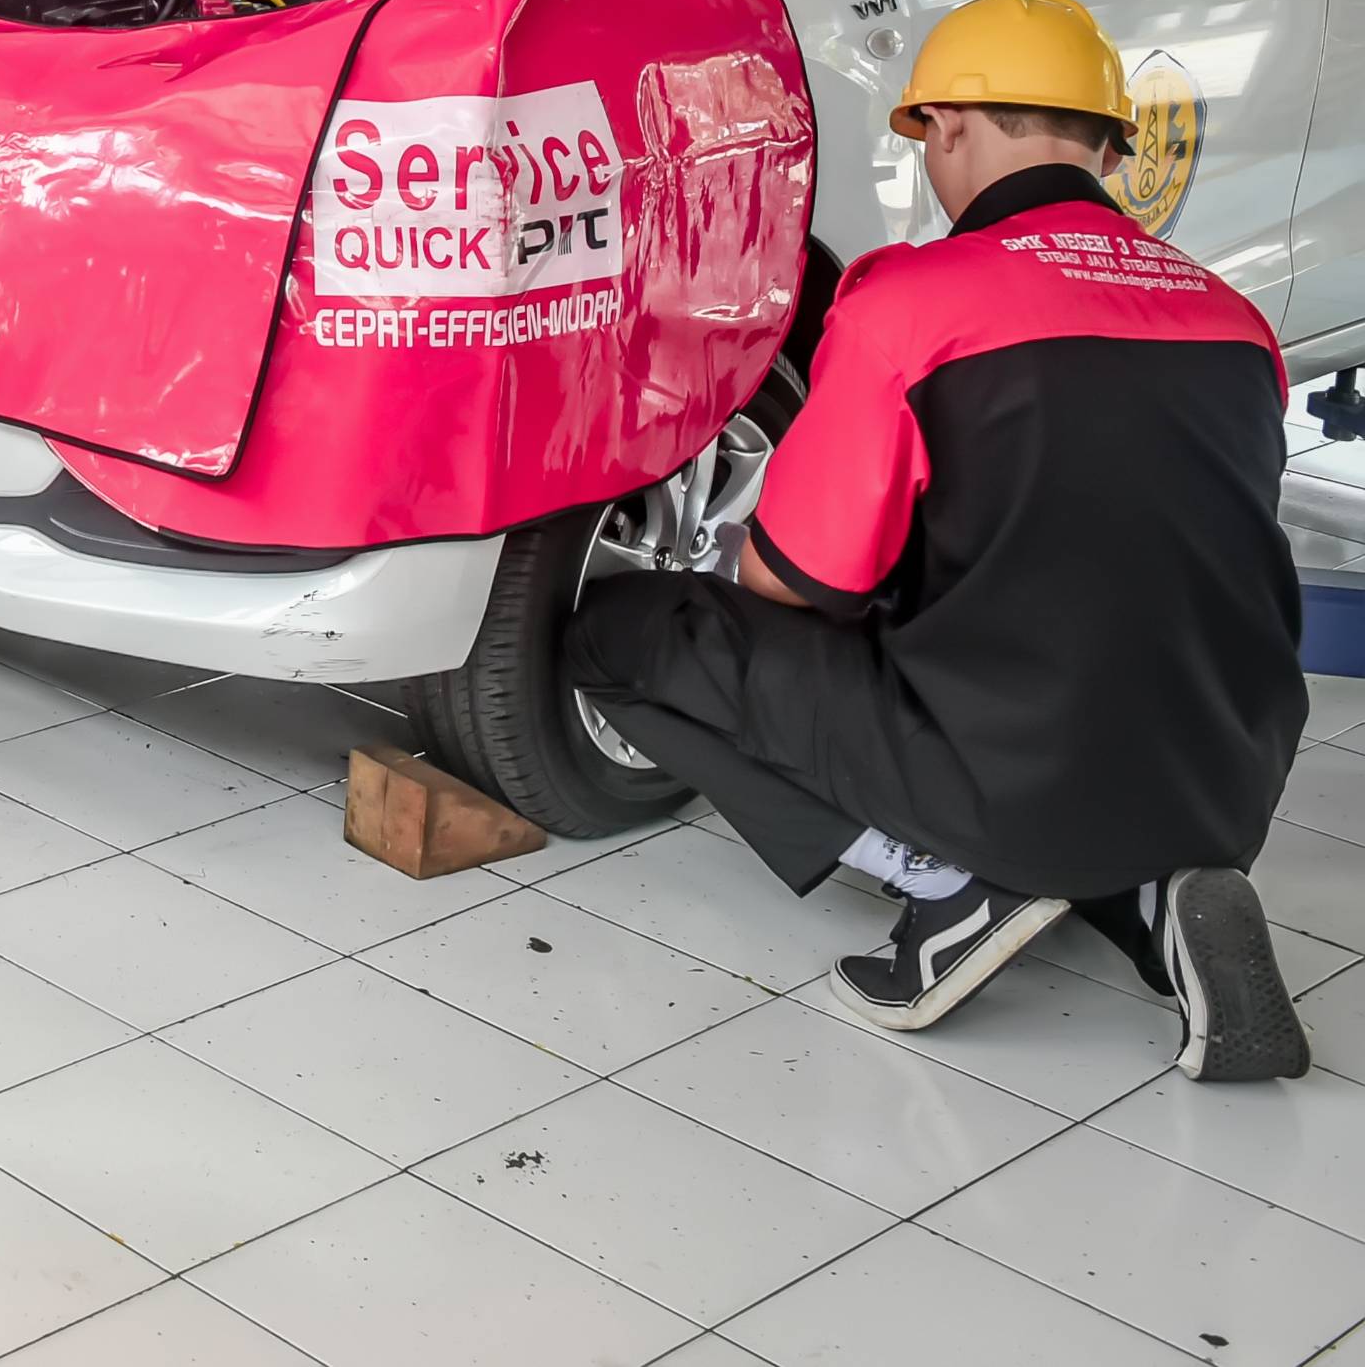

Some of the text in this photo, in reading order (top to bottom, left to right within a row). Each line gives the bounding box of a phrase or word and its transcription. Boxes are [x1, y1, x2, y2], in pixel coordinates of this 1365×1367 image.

[332, 119, 612, 210] Service
[334, 208, 609, 271] QUICK PIT
[1000, 235, 1048, 251] SMK
[1050, 233, 1114, 253] NEGERI
[1117, 236, 1130, 255] 3
[315, 288, 623, 348] CEPAT-EFFISIEN-MUDAH
